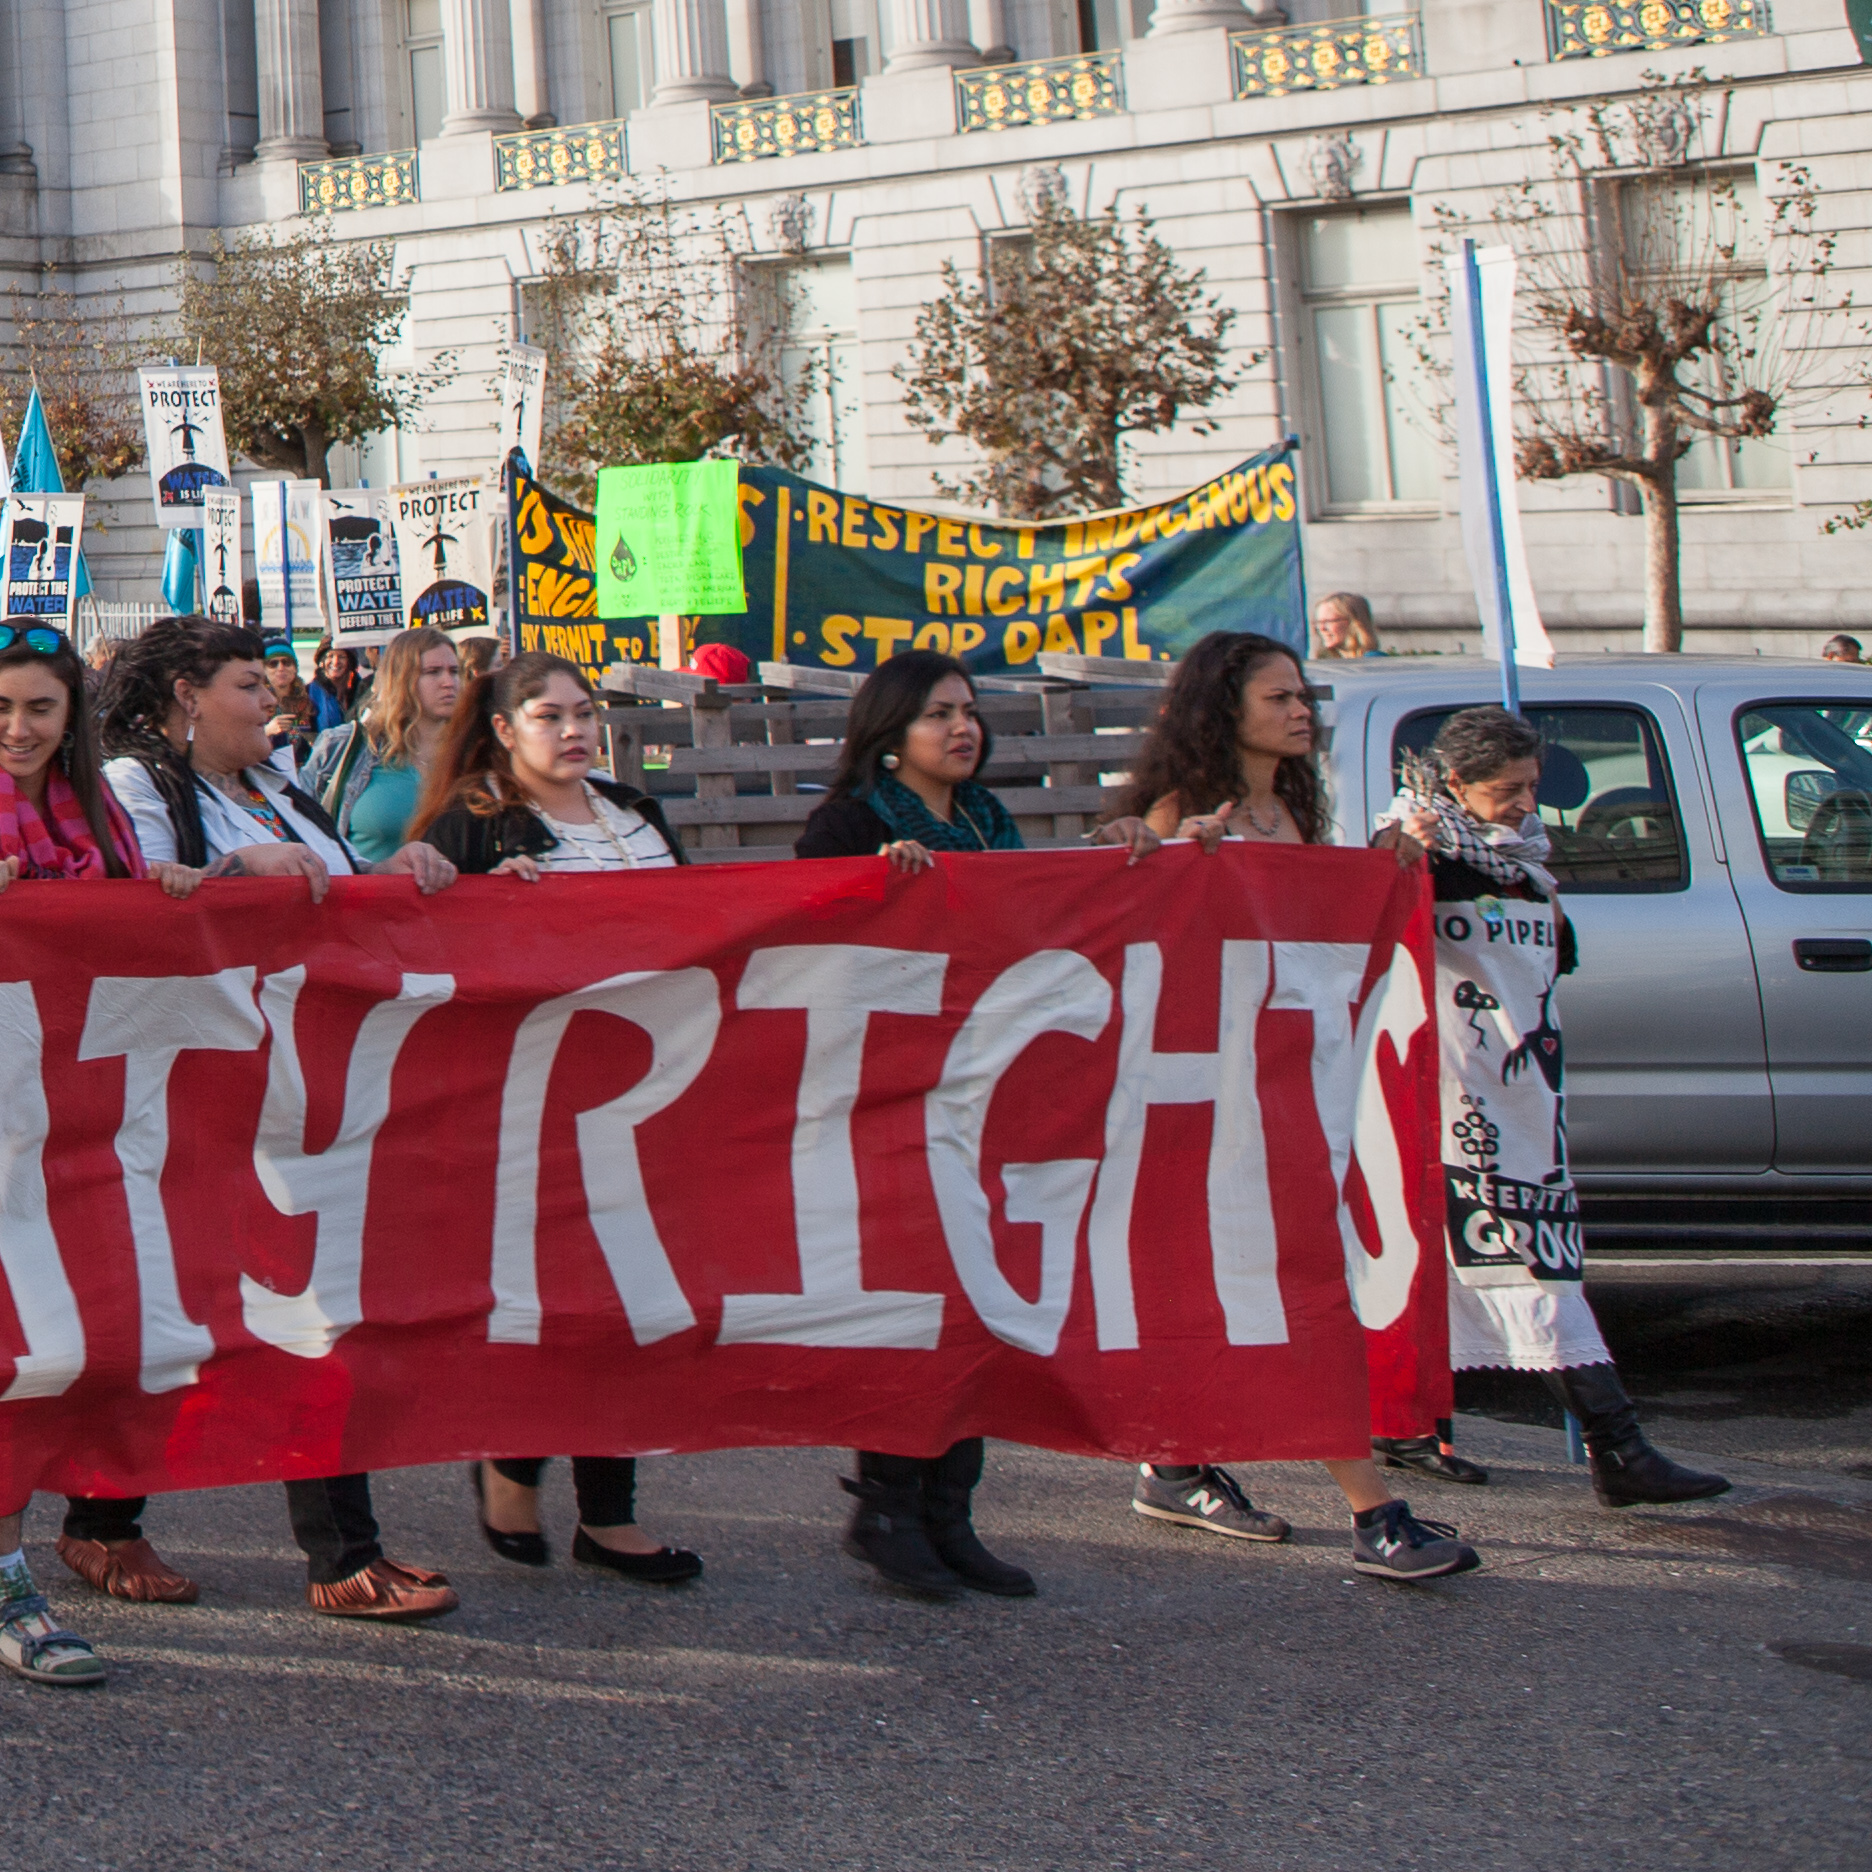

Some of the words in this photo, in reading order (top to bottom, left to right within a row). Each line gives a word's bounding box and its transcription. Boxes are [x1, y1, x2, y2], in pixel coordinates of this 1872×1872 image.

[150, 389, 217, 408] PROTECT
[619, 468, 703, 490] SOLIDARITY
[399, 489, 480, 521] PROTECT
[643, 490, 672, 502] WITH
[614, 503, 669, 521] STANDING
[1064, 462, 1295, 553] INDIGENOUS
[9, 581, 49, 595] PROTECT
[51, 581, 67, 595] THE
[337, 578, 392, 595] PROTECT
[924, 552, 1142, 617] RIGHTS
[9, 595, 66, 614] WATER
[338, 591, 402, 612] WATE
[417, 586, 480, 616] WATER
[339, 612, 376, 630] DEFEND
[377, 612, 395, 626] THE
[428, 612, 440, 625] IS
[441, 608, 465, 622] LIFE
[613, 636, 644, 661] TO
[487, 938, 1428, 1359] RIGHTS
[1186, 1488, 1224, 1516] N
